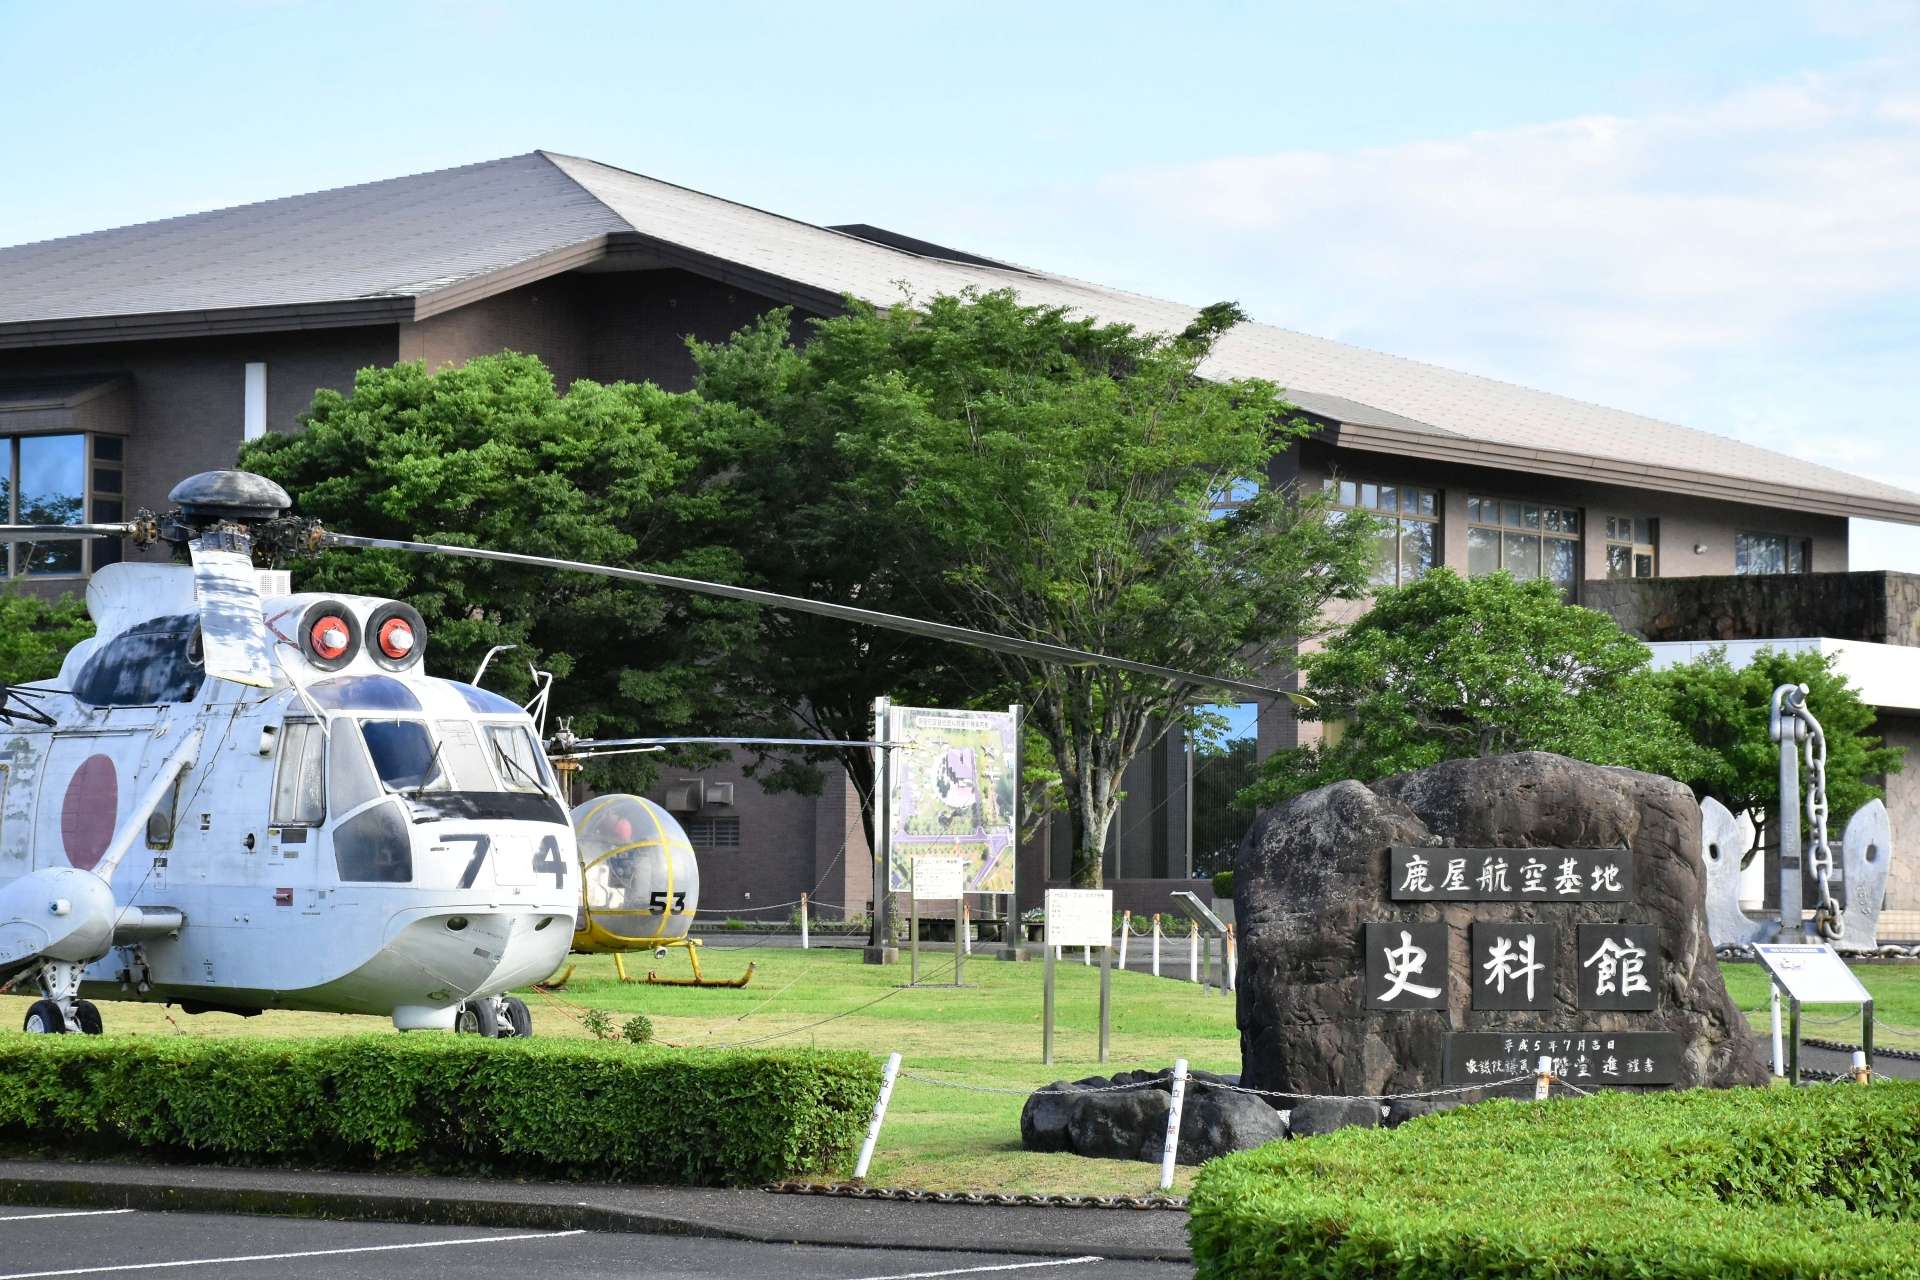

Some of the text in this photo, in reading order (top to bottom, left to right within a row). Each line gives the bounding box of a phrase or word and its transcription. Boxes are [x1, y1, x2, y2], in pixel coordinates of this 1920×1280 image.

[1399, 854, 1625, 894] 鹿屋航空基地
[649, 892, 687, 916] 53
